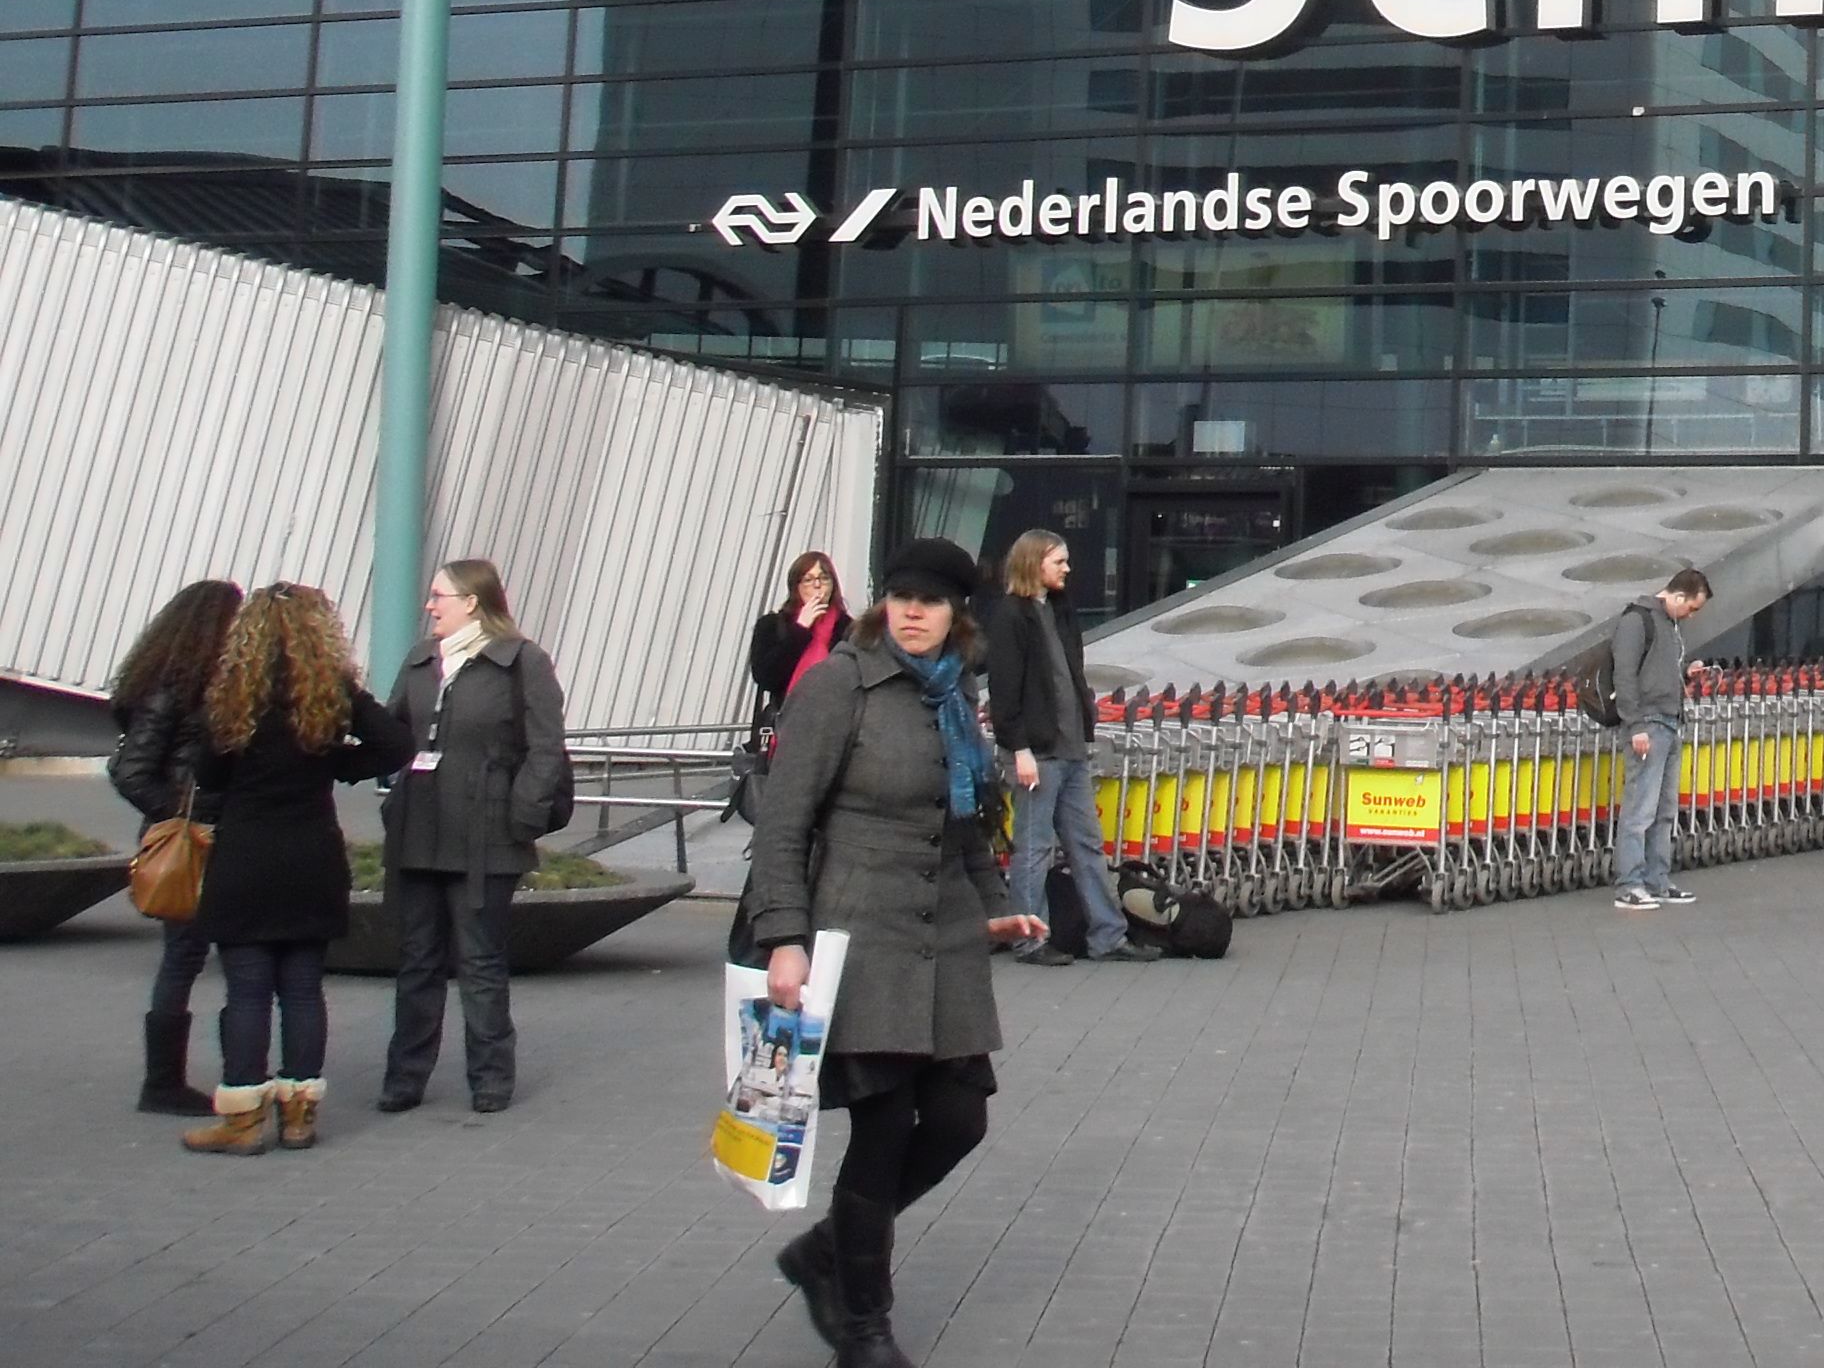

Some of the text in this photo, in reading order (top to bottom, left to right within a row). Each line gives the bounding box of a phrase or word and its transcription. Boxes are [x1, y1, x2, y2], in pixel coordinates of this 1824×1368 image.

[916, 169, 1776, 241] Nederlandse Spoorwegen
[1361, 791, 1426, 809] Sunweb
